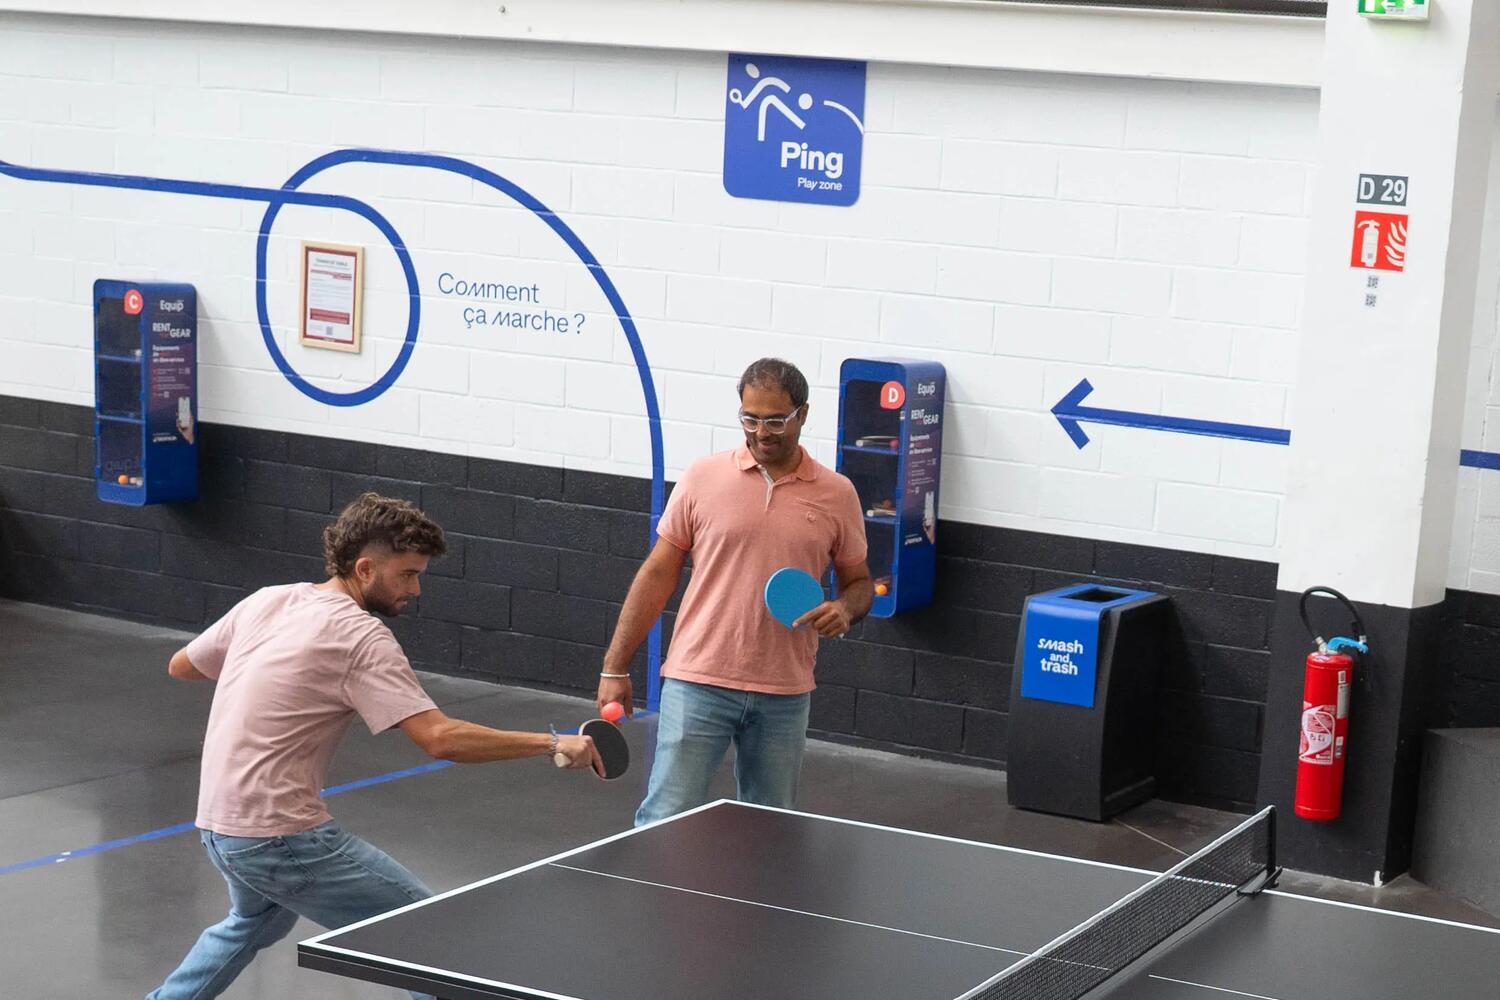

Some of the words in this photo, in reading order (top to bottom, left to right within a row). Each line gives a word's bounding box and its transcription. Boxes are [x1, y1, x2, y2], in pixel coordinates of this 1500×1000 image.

[780, 141, 844, 179] Ping
[797, 176, 818, 191] Play
[819, 180, 843, 191] zone
[1360, 177, 1375, 200] D
[1381, 178, 1406, 203] 29
[438, 272, 540, 304] Comment
[129, 294, 139, 309] C
[463, 307, 487, 329] ça
[492, 310, 569, 333] marche
[889, 387, 899, 403] D
[1037, 638, 1084, 654] smash
[1050, 653, 1070, 663] and
[1041, 658, 1078, 675] trash
